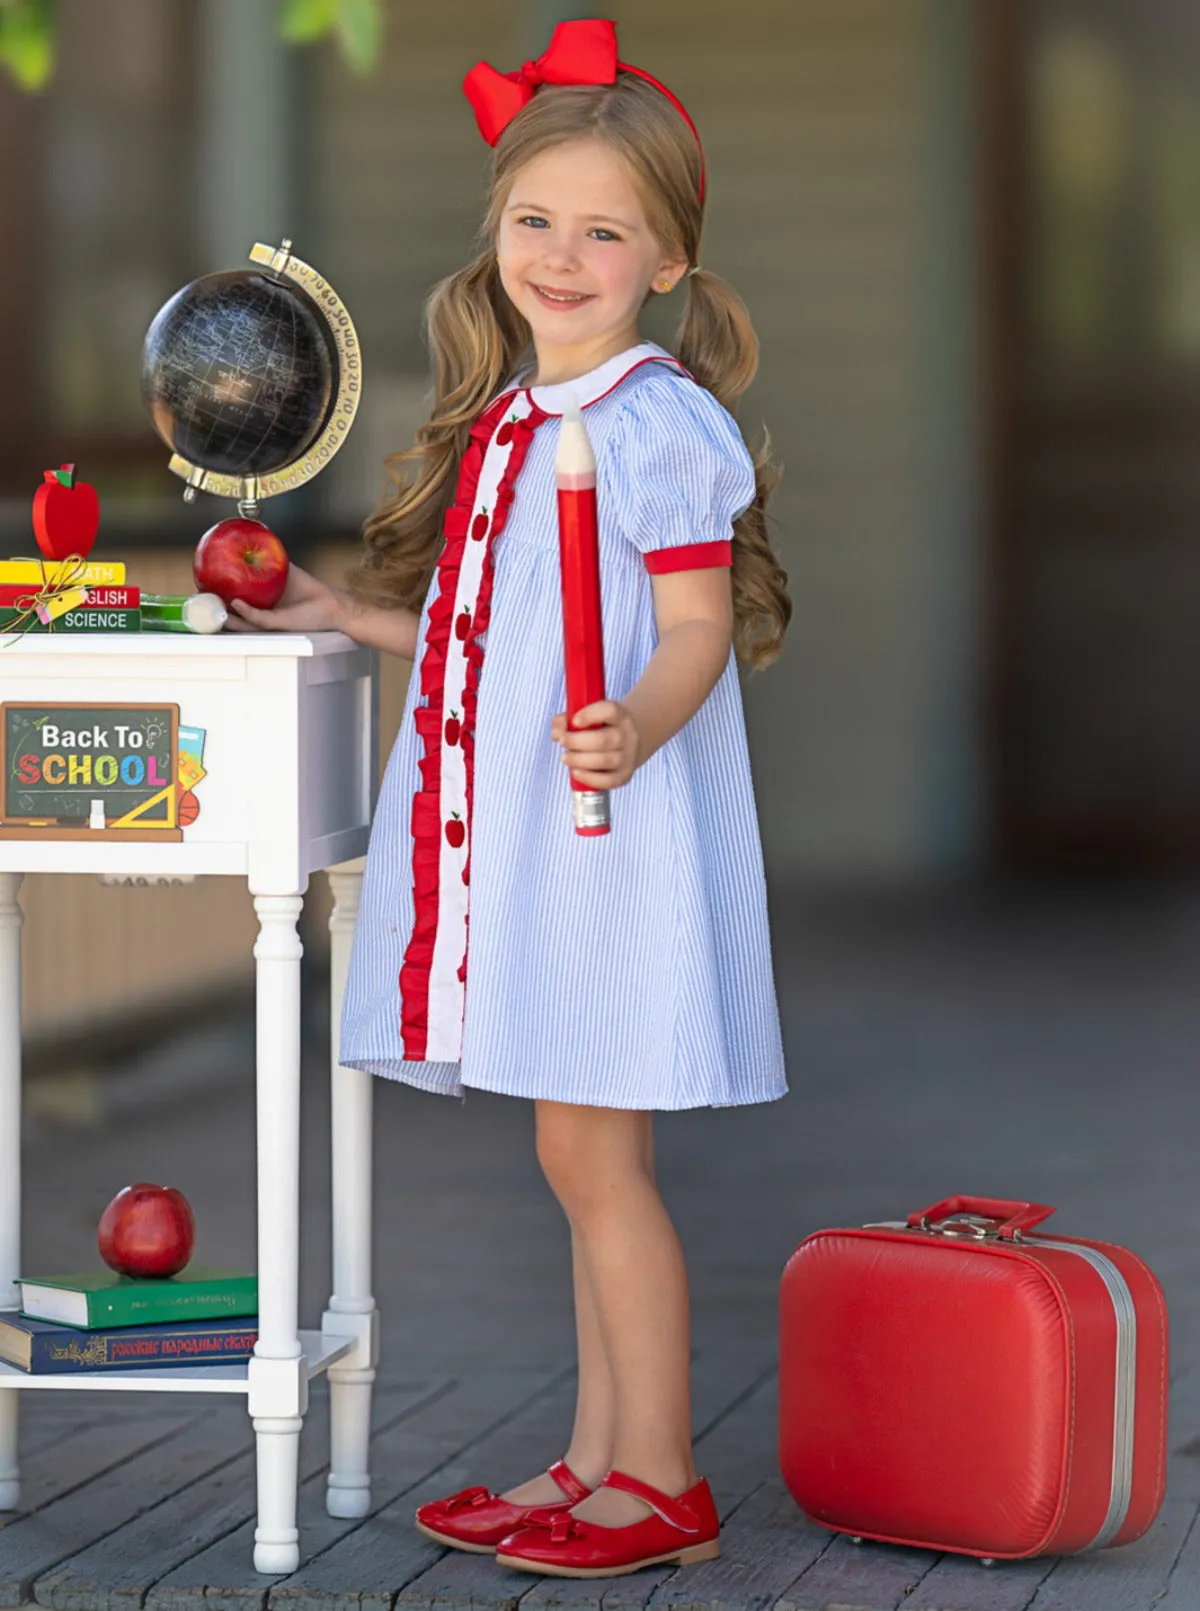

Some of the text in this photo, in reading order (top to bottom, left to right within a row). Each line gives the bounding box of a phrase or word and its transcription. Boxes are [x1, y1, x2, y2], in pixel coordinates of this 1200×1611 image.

[321, 289, 338, 306] 60
[333, 308, 349, 327] 50
[344, 328, 356, 348] 40
[346, 351, 359, 369] 30
[348, 373, 359, 392] 20
[343, 397, 354, 414] 10
[326, 433, 338, 449] 10
[315, 447, 329, 464] 20
[84, 590, 128, 605] GLISH
[64, 612, 127, 628] SCIENCE
[42, 725, 143, 748] Back To
[17, 753, 168, 786] SCHOOL
